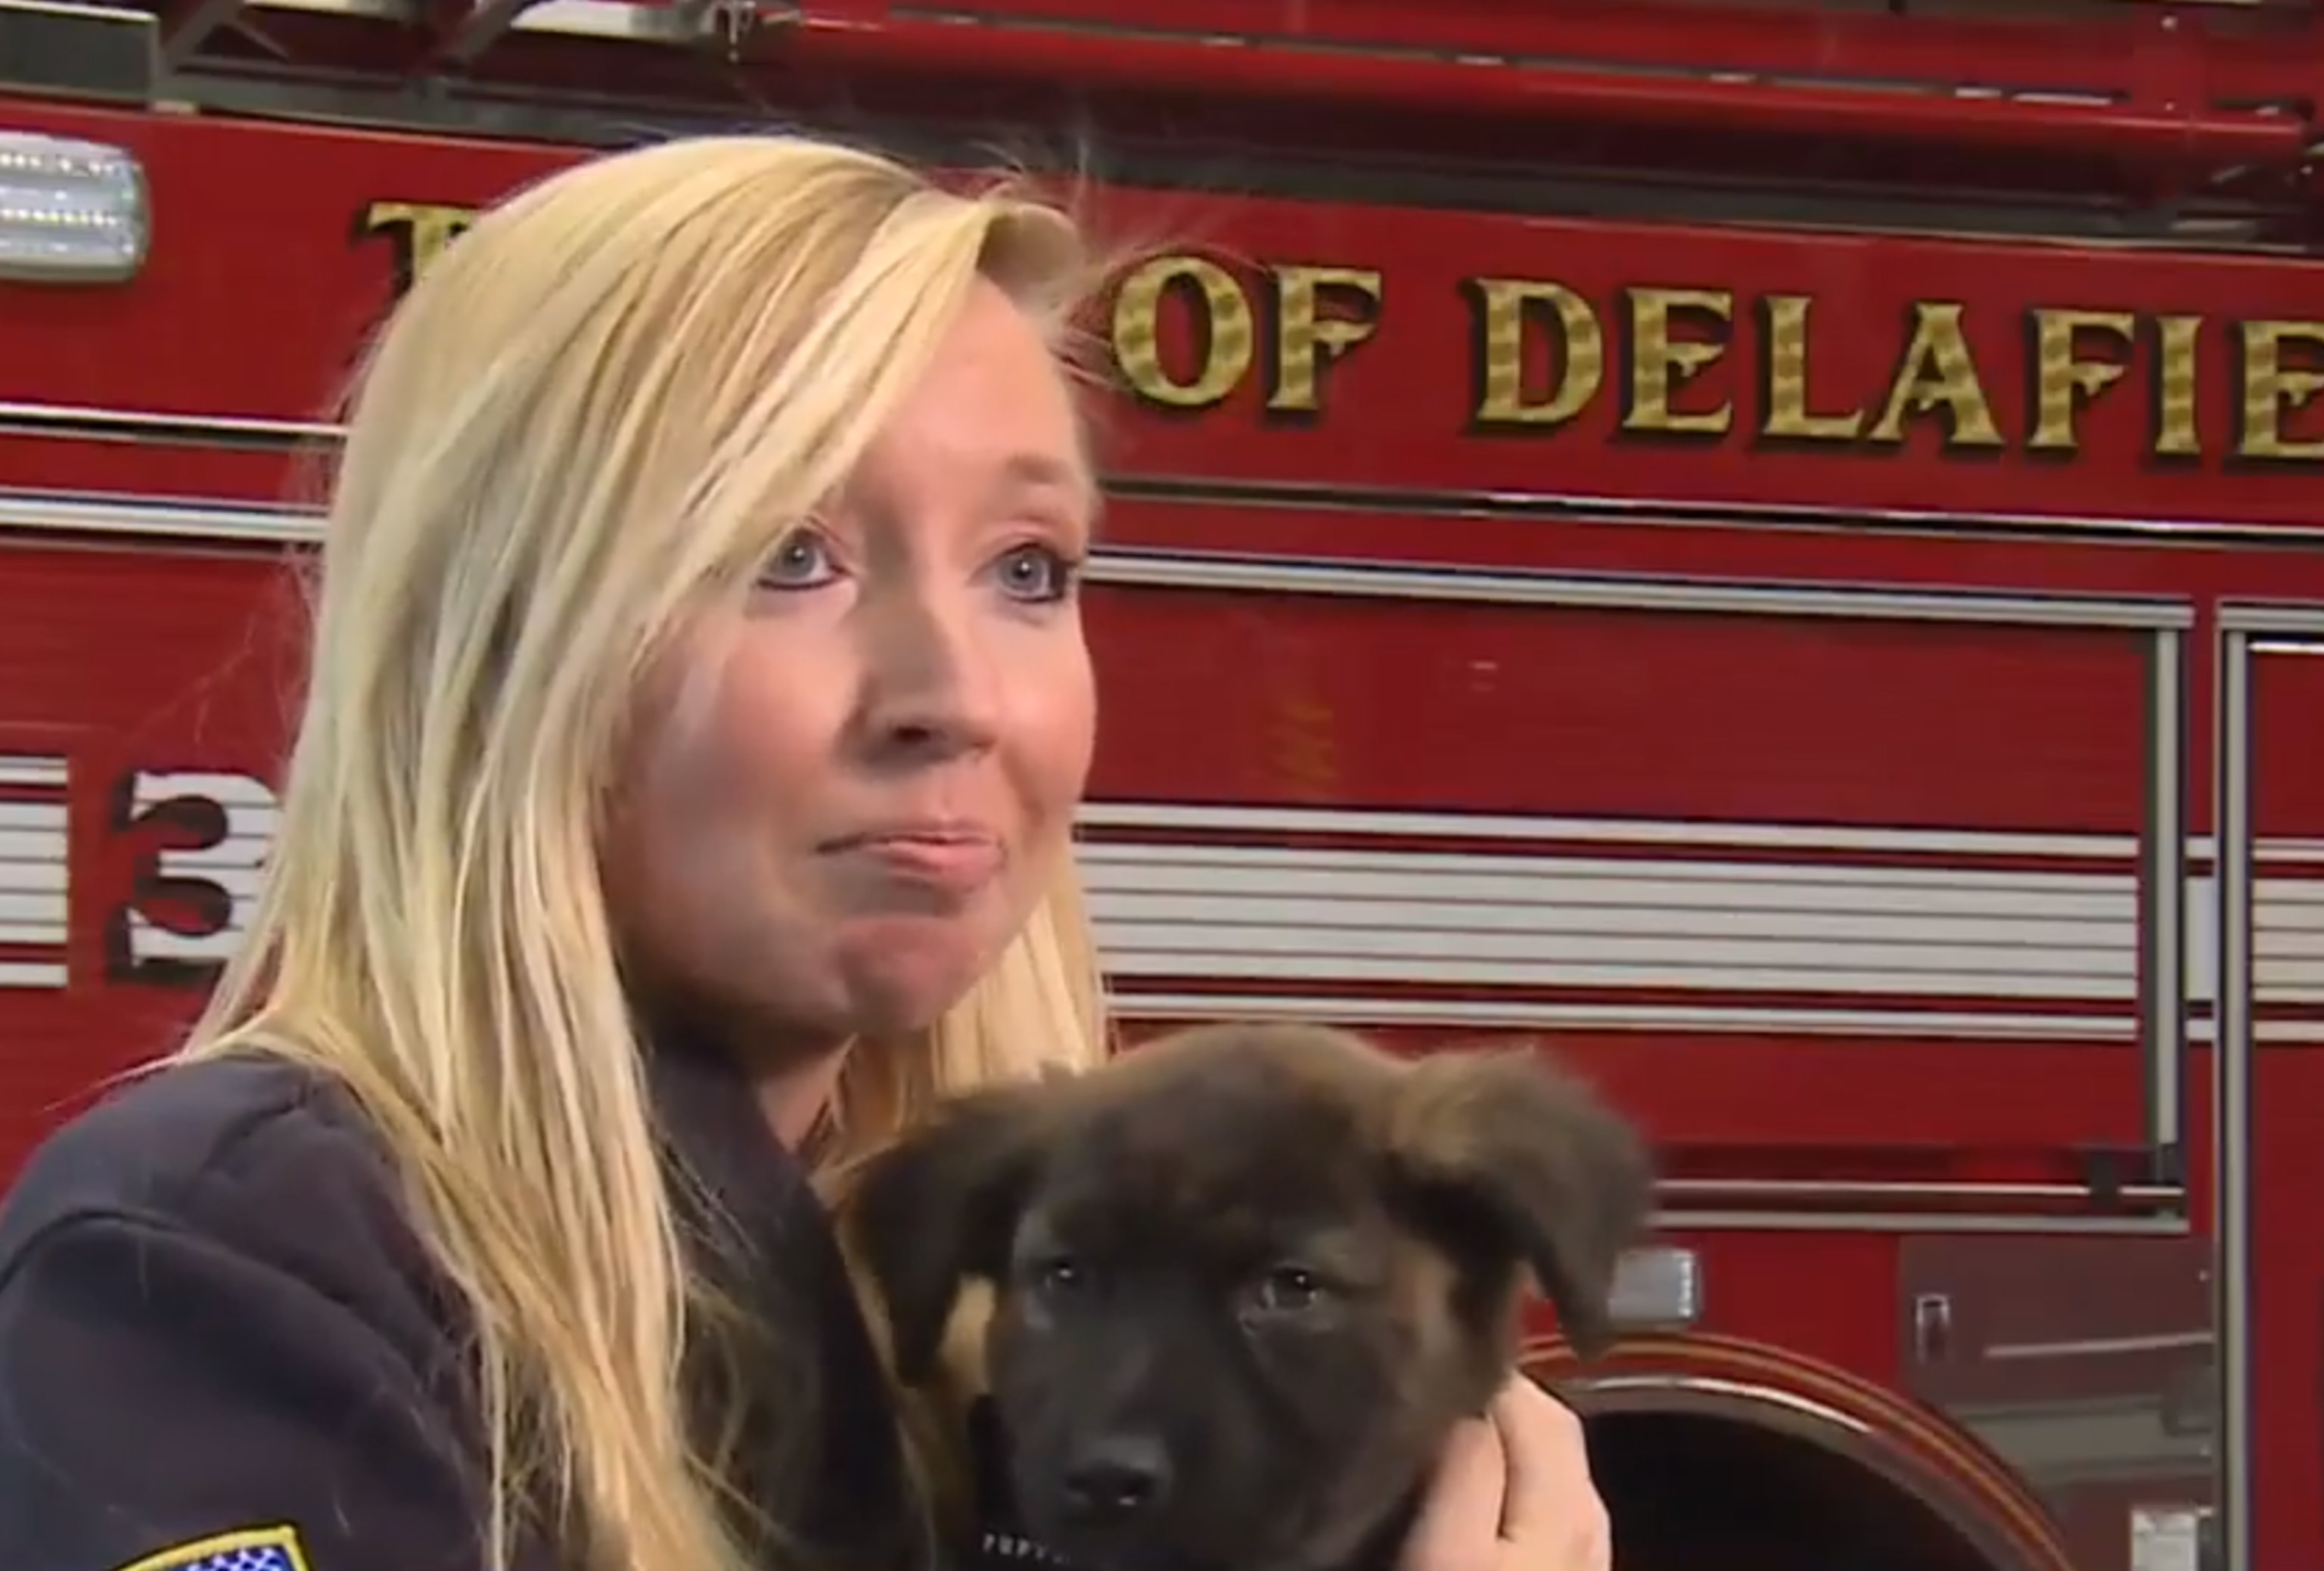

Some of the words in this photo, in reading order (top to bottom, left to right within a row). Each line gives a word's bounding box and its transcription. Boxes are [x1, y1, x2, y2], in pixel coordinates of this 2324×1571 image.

[1112, 255, 1383, 411] OF
[1474, 275, 2324, 460] DELAFIE
[124, 769, 284, 970] 3
